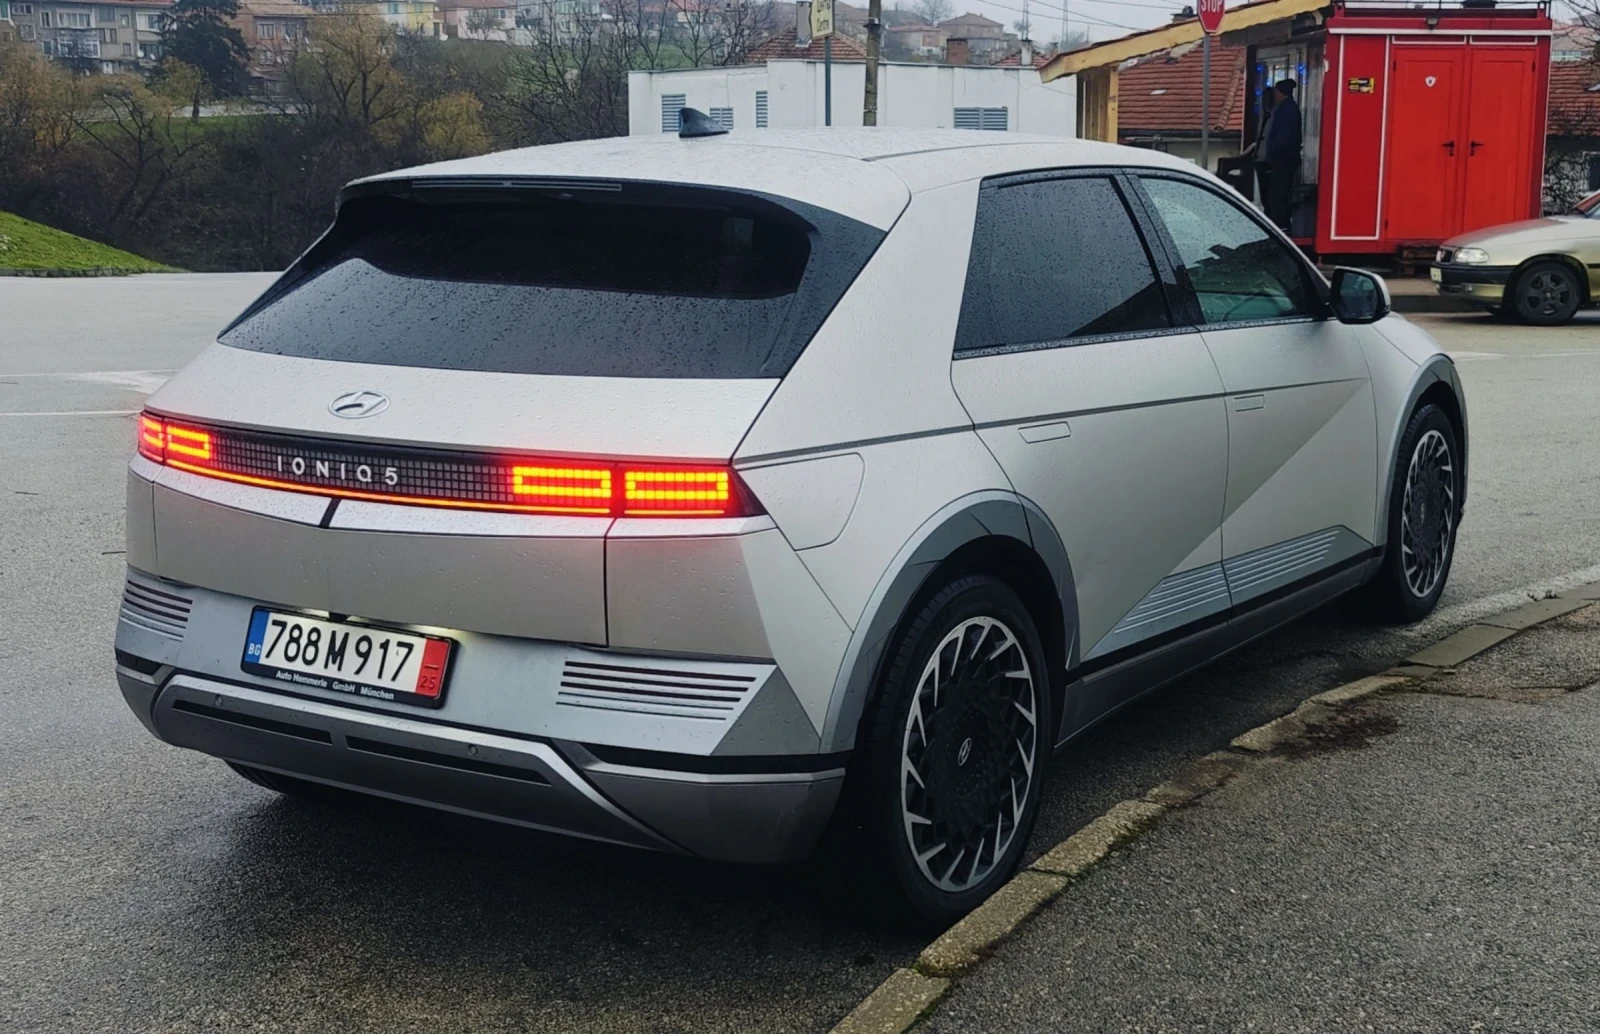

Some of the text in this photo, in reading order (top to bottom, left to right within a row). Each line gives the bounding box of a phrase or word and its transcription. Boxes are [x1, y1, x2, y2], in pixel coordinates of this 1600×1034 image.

[1201, 0, 1223, 12] STOP
[277, 455, 398, 485] IONIQ 5
[248, 643, 261, 656] BG
[276, 670, 395, 700] Auto Hemmerle GmbH München
